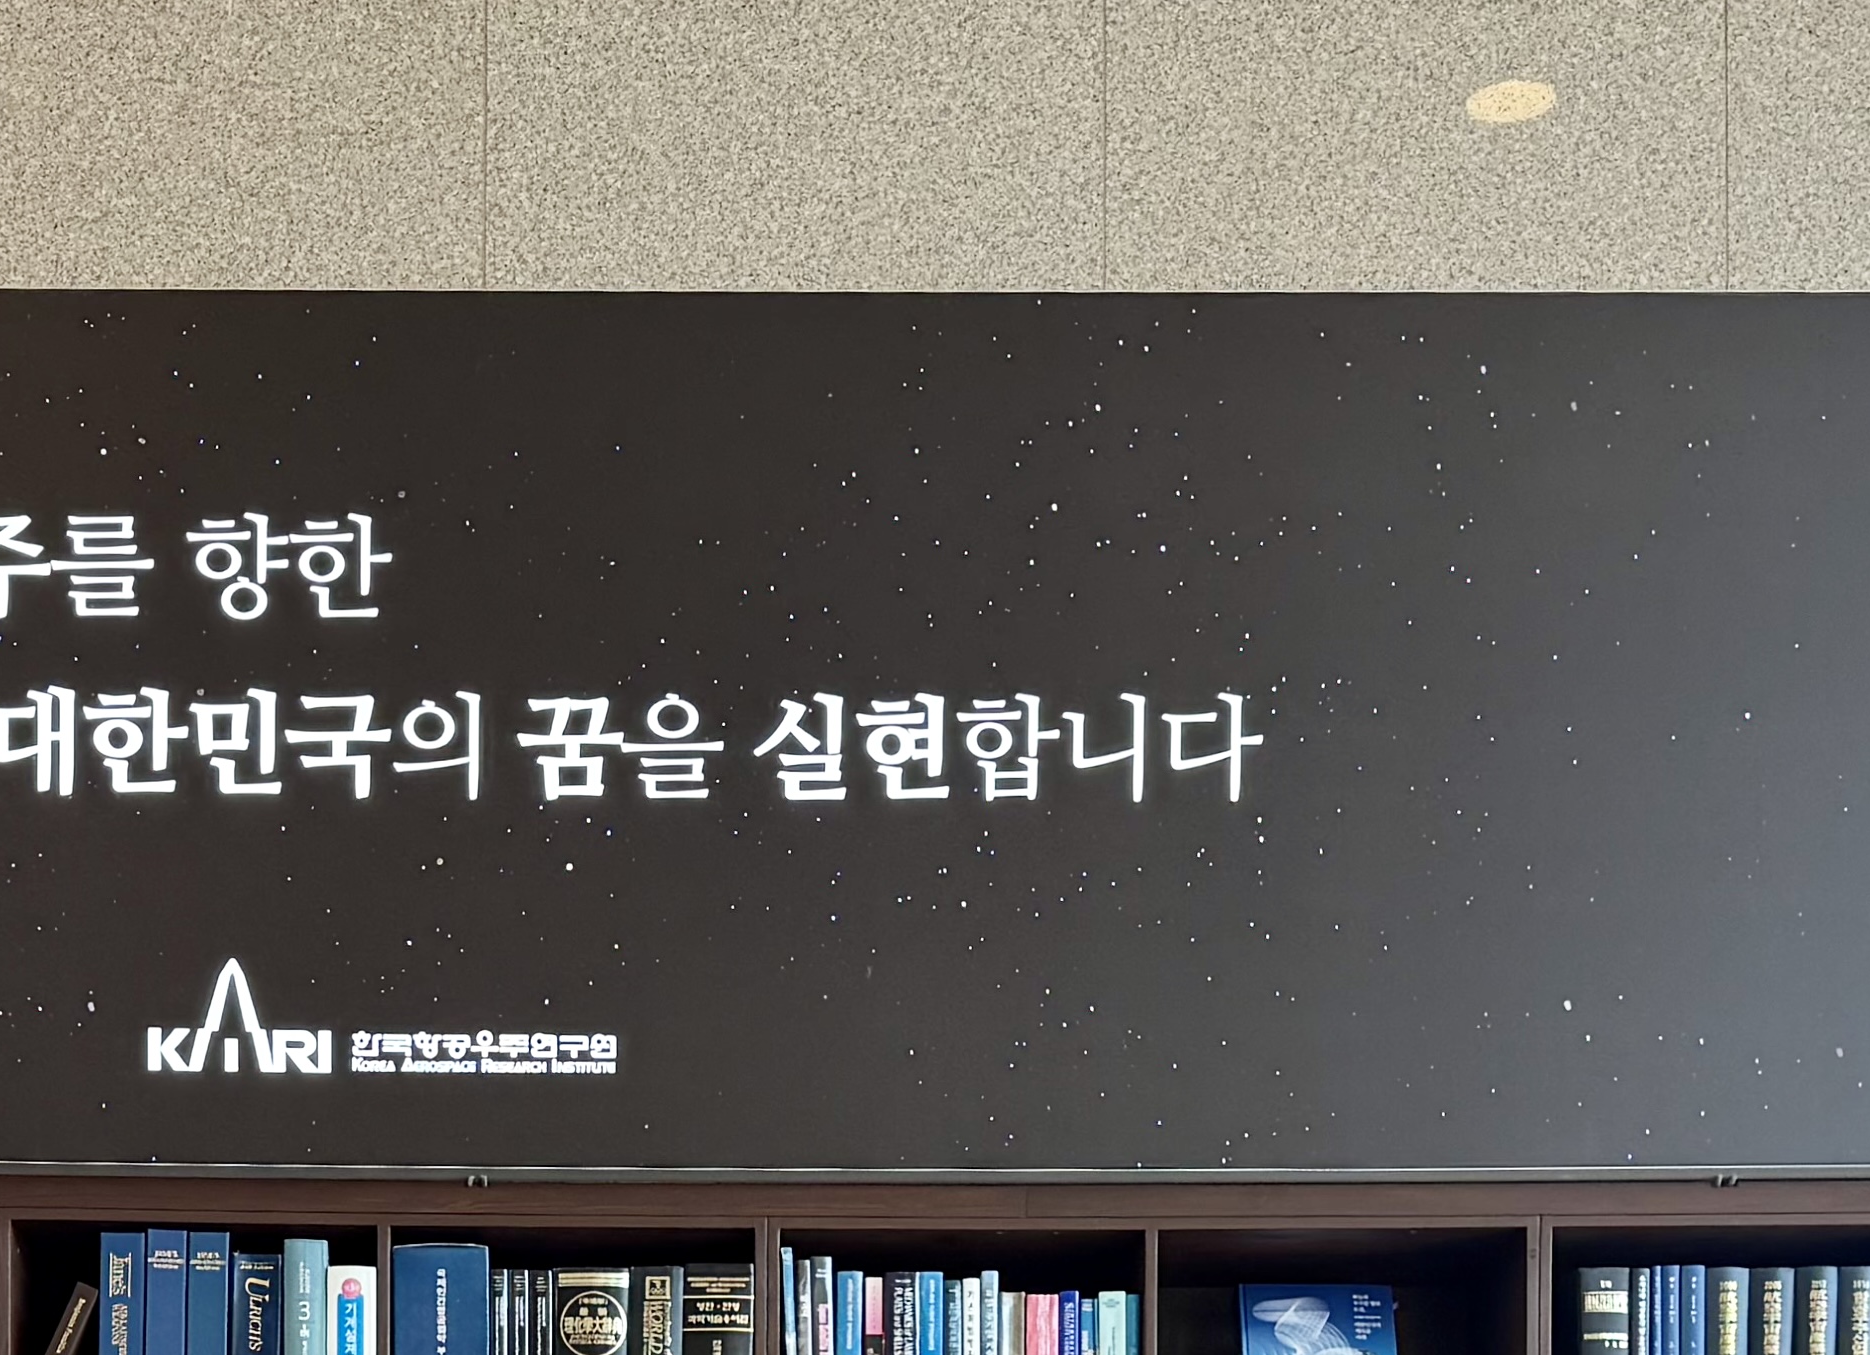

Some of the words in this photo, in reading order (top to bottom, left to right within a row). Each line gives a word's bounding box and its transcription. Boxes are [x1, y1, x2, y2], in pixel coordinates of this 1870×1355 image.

[185, 511, 393, 620] 향한
[516, 692, 725, 801] 꿈을
[753, 691, 1263, 802] 실현합니다
[147, 957, 332, 1074] KARI
[351, 1029, 618, 1059] 한국항공우주연구원
[351, 1058, 397, 1074] KOREA
[401, 1058, 477, 1074] AEROSPACE
[481, 1059, 548, 1075] RESEARCH
[551, 1059, 617, 1075] INSTITUTE
[649, 1301, 664, 1355] WORLD
